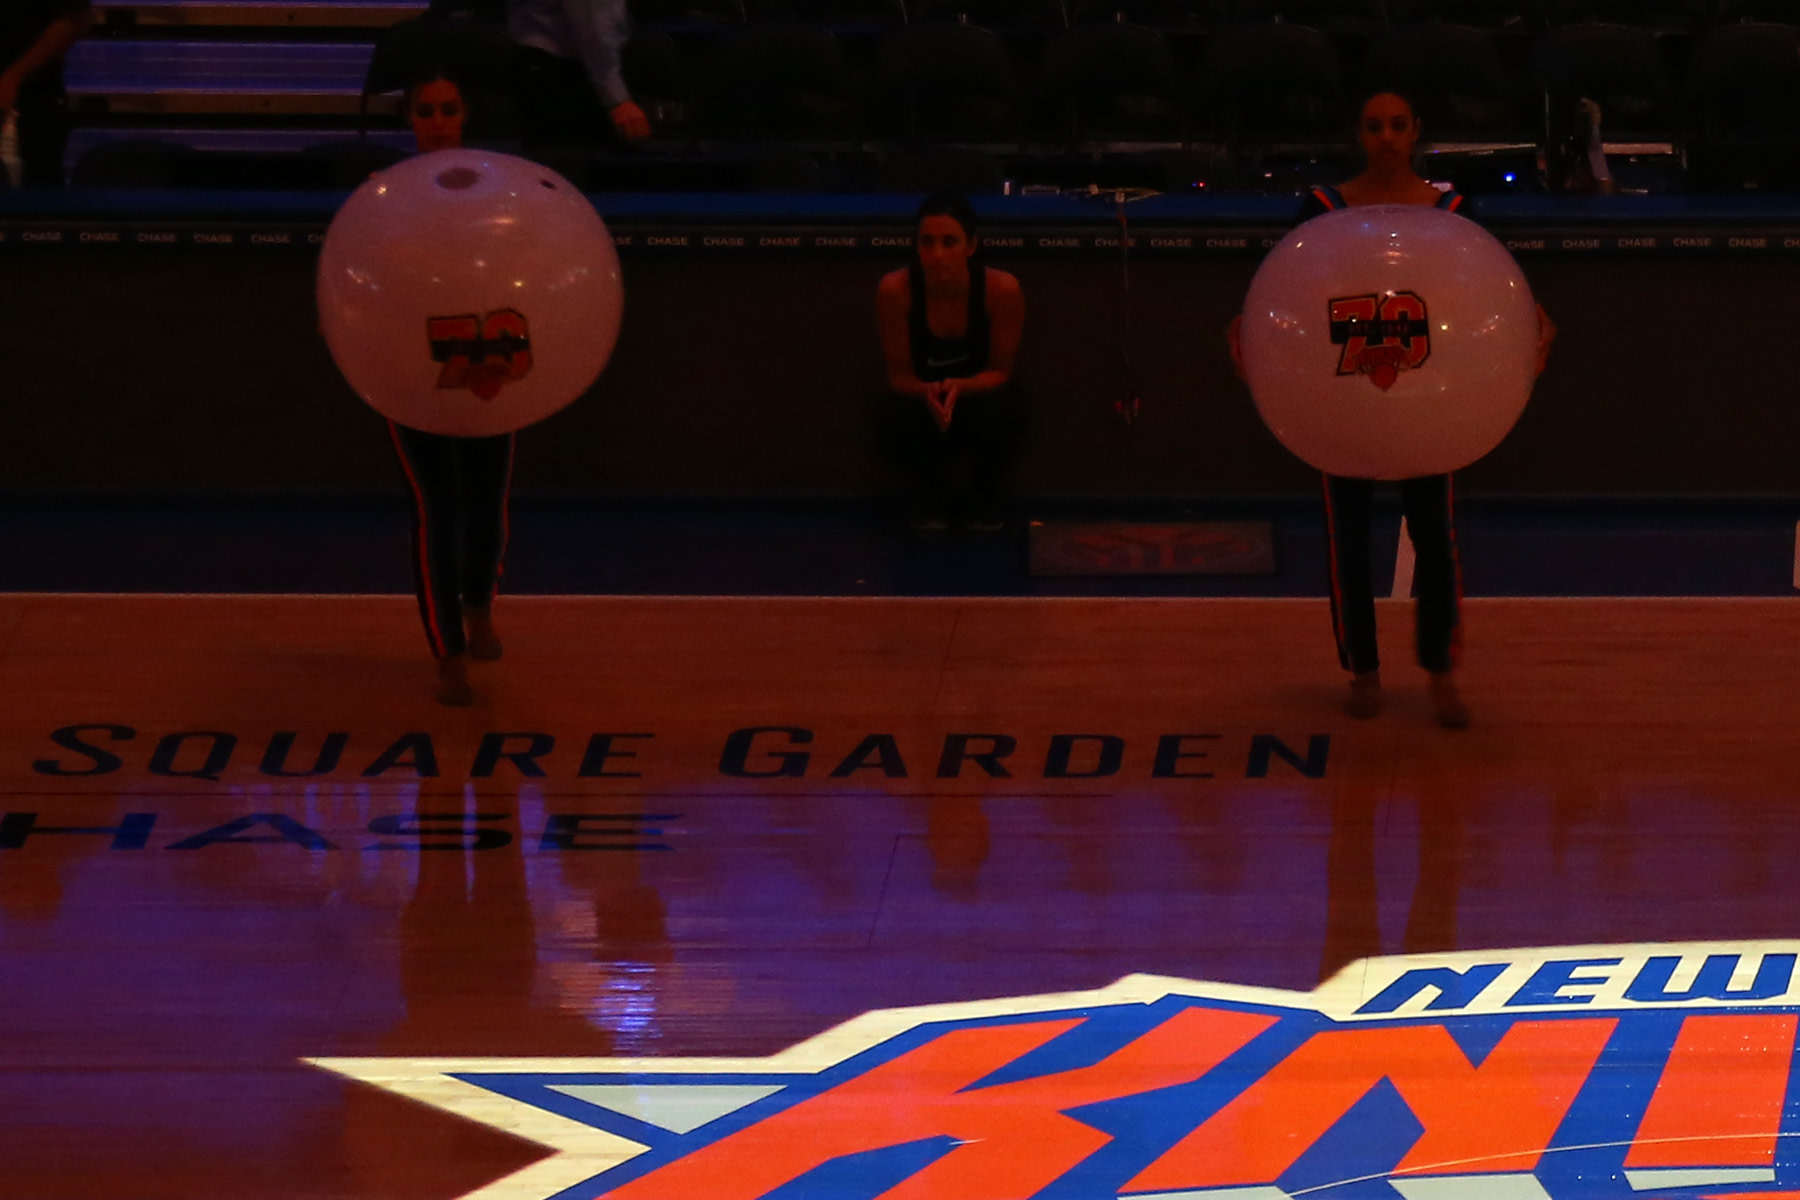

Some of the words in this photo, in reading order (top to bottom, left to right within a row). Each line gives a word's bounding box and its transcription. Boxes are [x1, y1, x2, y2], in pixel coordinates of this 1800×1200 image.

[21, 231, 63, 242] CHASE
[79, 231, 120, 242] CHASE
[136, 232, 177, 243] CHASE
[193, 233, 234, 244] CHASE
[250, 233, 291, 244] CHASE
[647, 236, 688, 247] CHASE
[703, 236, 745, 247] CHASE
[759, 236, 801, 247] CHASE
[815, 236, 857, 247] CHASE
[871, 236, 912, 247] CHASE
[982, 237, 1024, 248] CHASE
[1038, 237, 1080, 248] CHASE
[1150, 237, 1193, 248] CHASE
[1205, 238, 1248, 249] CHASE
[1506, 238, 1546, 249] CHASE
[1561, 238, 1601, 249] CHASE
[1617, 237, 1657, 248] CHASE
[1672, 237, 1713, 248] CHASE
[1728, 237, 1768, 249] CHASE
[1329, 290, 1430, 376] 70
[32, 724, 655, 781] SQUARE
[717, 726, 1331, 778] GARDEN
[1352, 952, 1800, 1015] NEW
